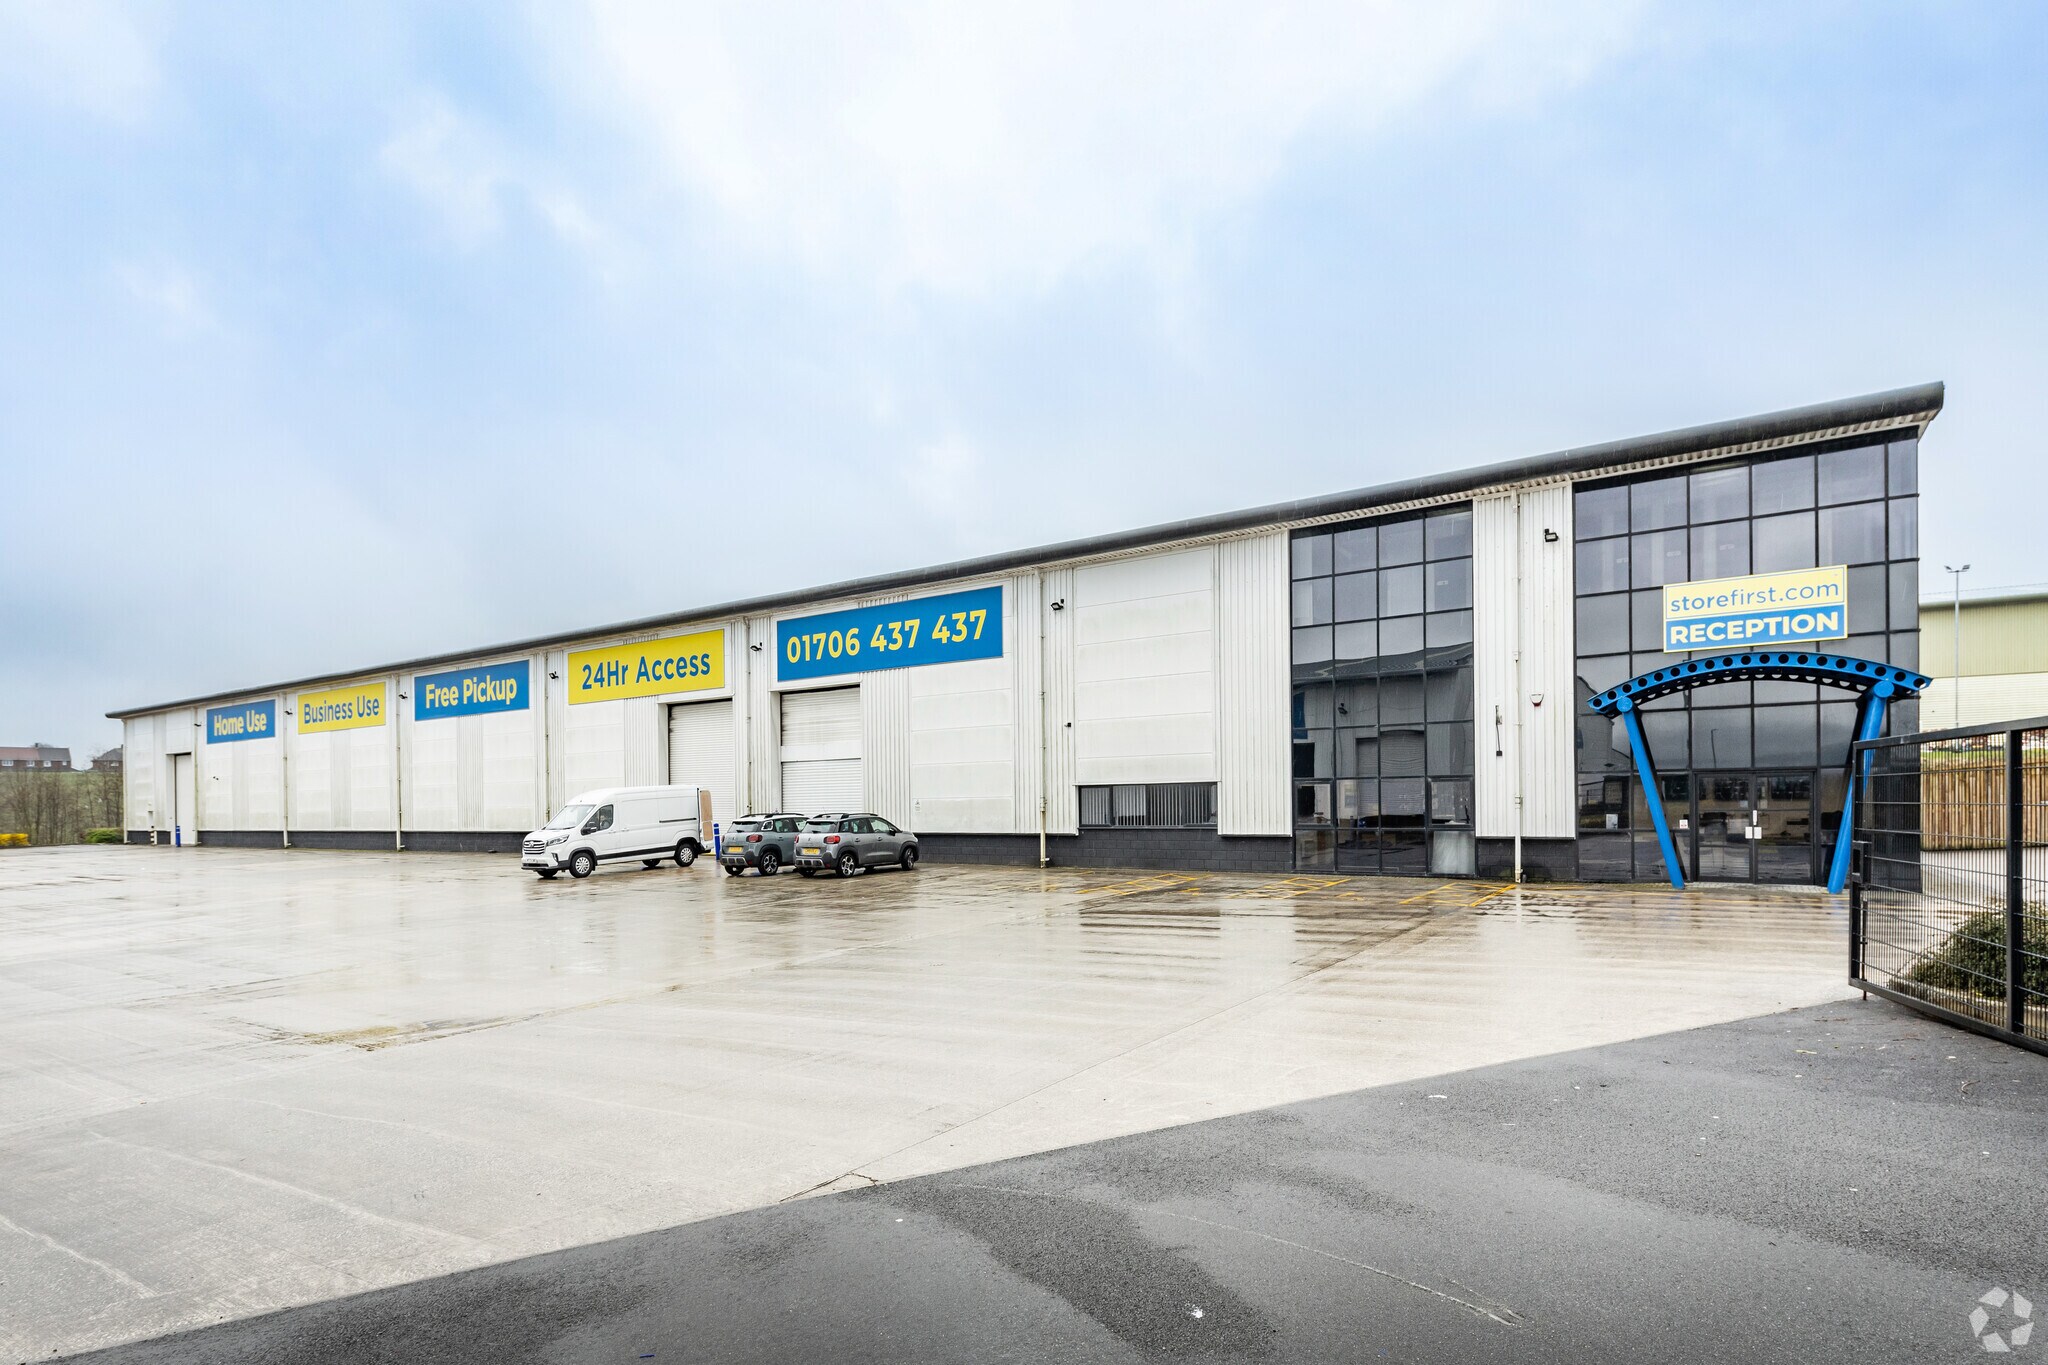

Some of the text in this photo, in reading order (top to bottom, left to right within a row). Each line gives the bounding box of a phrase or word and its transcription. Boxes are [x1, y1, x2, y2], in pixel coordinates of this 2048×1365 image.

[1671, 583, 1839, 612] storefirst.com
[786, 609, 987, 664] 01706 437 437
[1669, 611, 1839, 645] RECEPTION
[581, 652, 711, 691] 24Hr Access
[425, 674, 517, 709] Free Pickup
[213, 709, 267, 737] Home Use
[303, 695, 380, 725] Business Use
